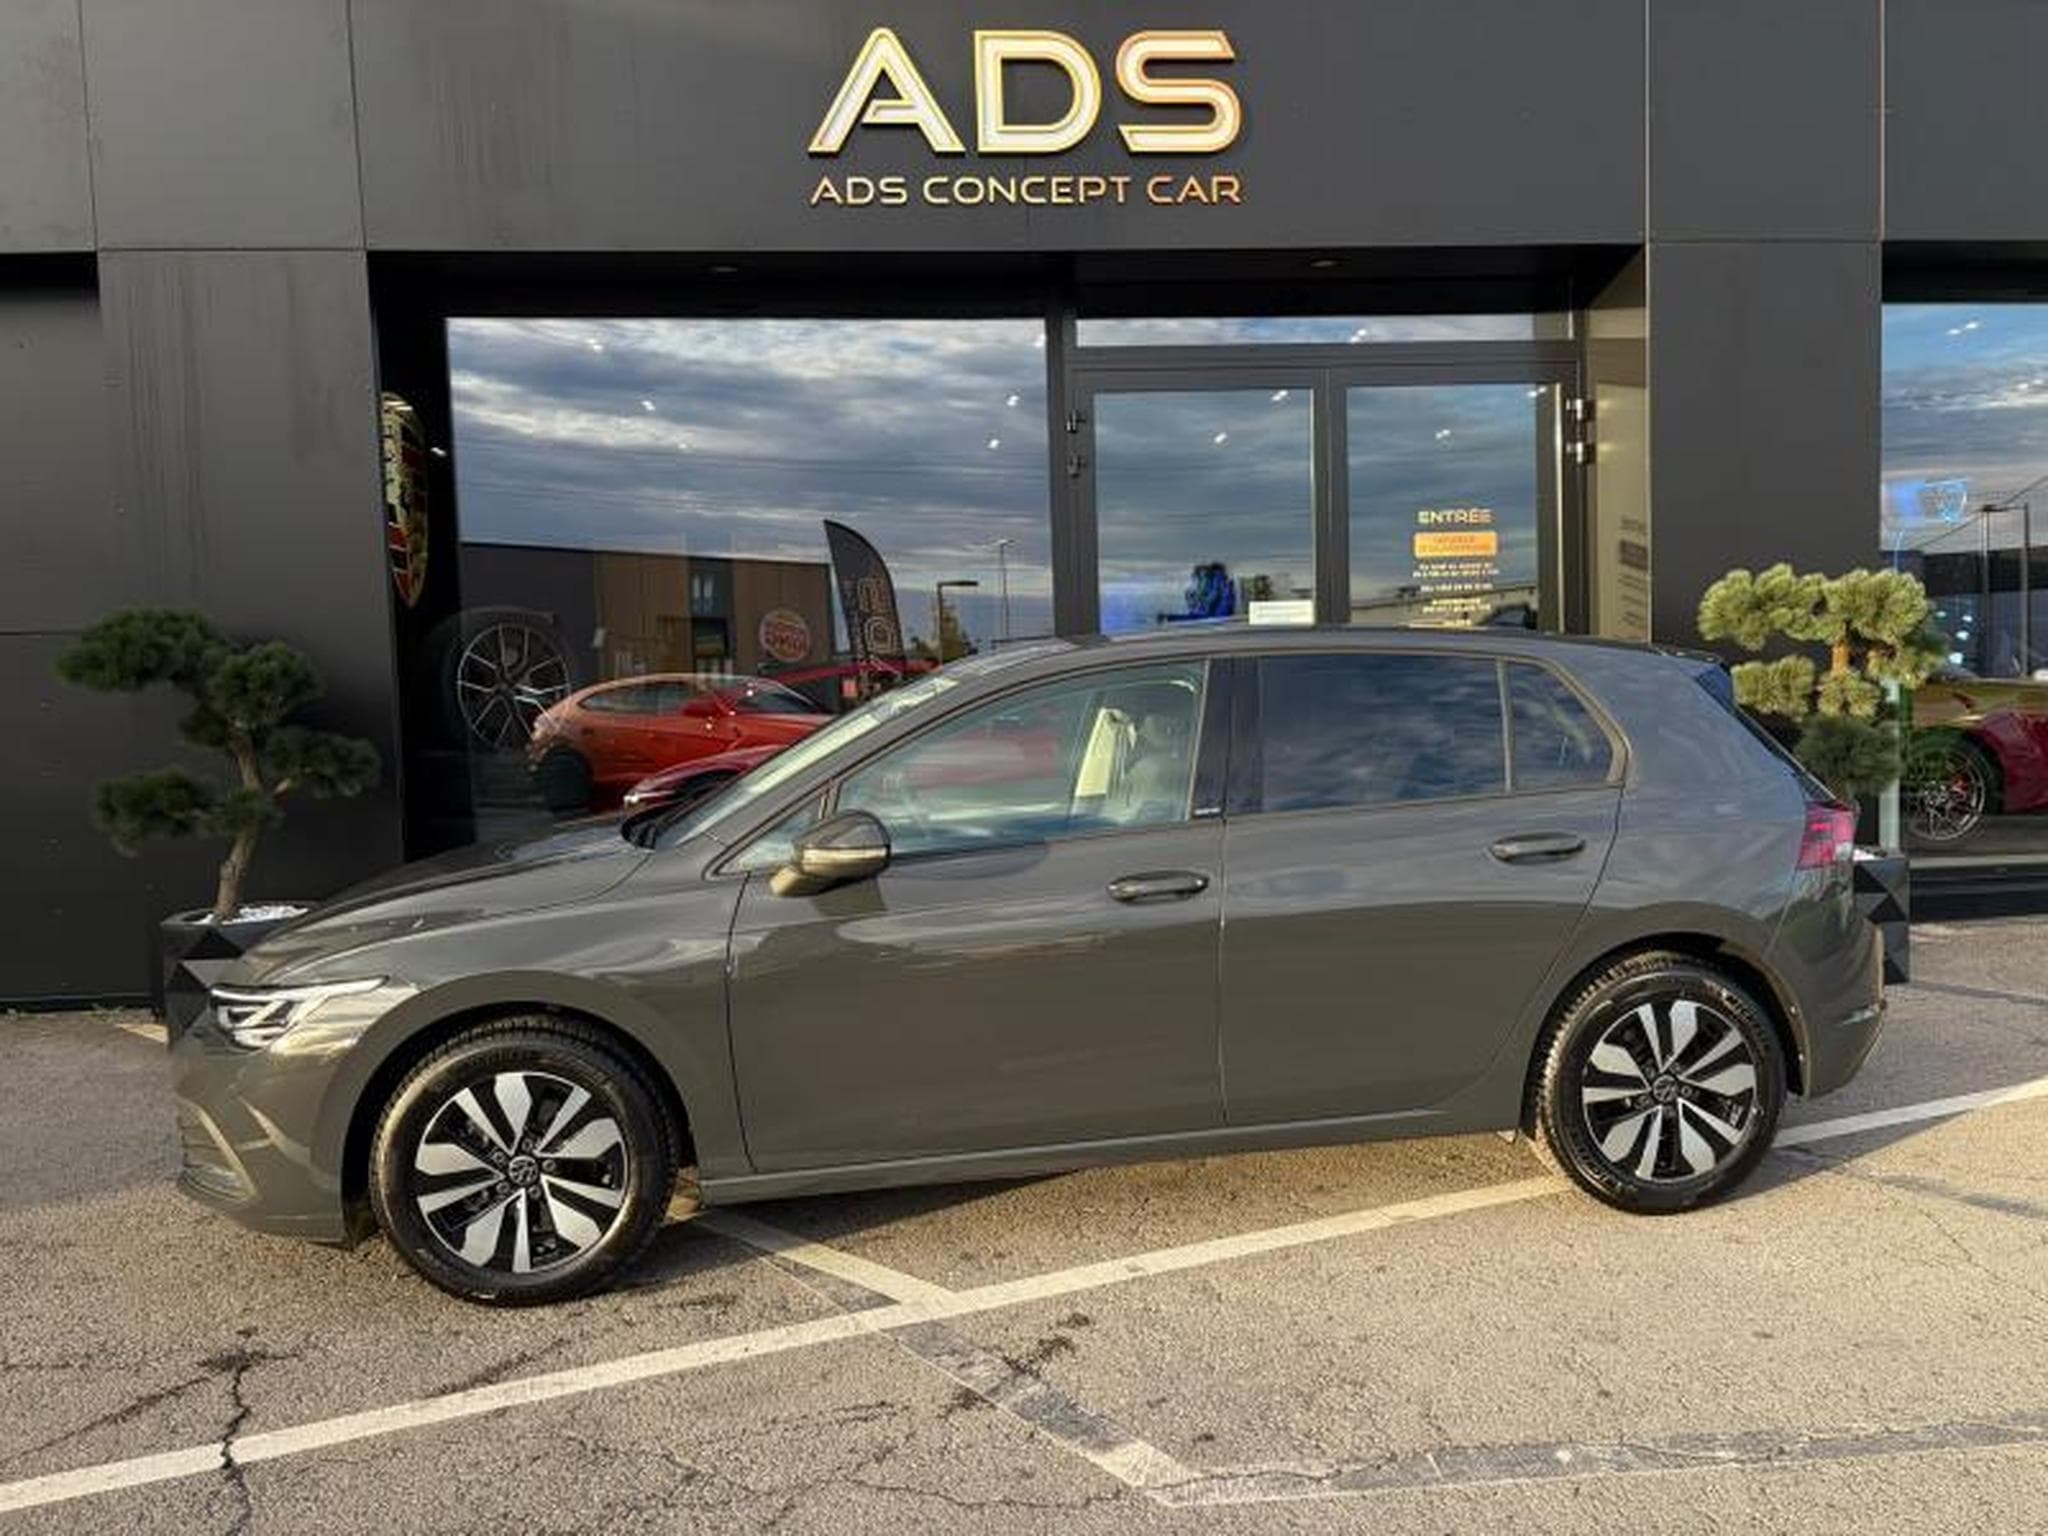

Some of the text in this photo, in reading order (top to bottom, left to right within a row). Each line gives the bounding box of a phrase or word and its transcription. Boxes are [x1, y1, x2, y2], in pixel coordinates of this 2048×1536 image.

[808, 27, 1242, 154] ADS
[810, 175, 1242, 205] ADS CONCEPT CAR
